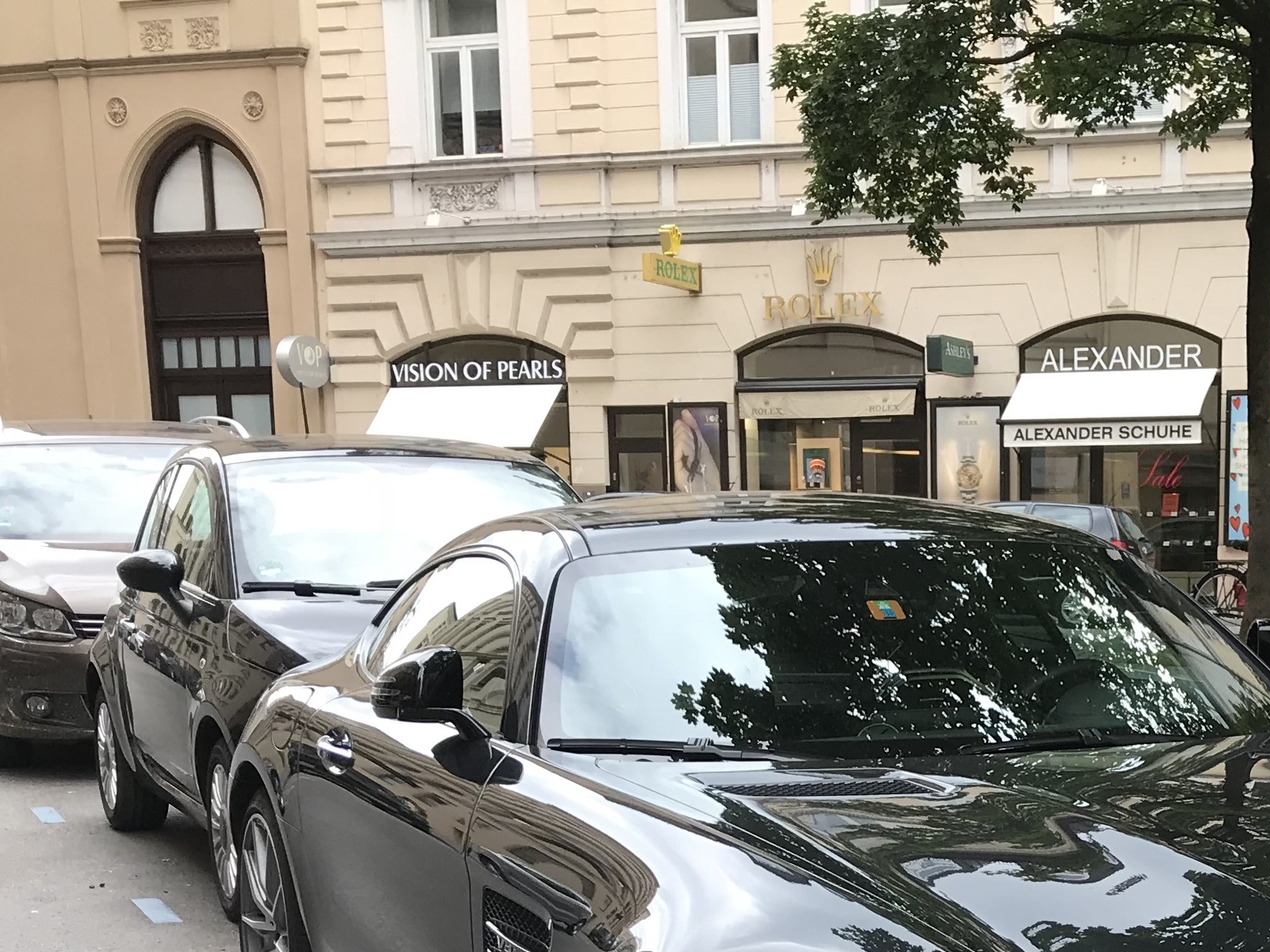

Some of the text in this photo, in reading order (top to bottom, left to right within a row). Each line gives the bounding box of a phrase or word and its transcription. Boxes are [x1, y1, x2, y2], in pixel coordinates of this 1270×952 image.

[656, 258, 698, 285] ROLEX
[763, 291, 884, 321] ROLEX
[1041, 344, 1202, 372] ALEXANDER
[392, 359, 563, 383] VISION OF PEARLS
[751, 407, 783, 416] ROLEX
[868, 404, 901, 413] ROLEX
[1014, 425, 1192, 441] ALEXANDER SCHUHE
[1138, 448, 1189, 488] Sale
